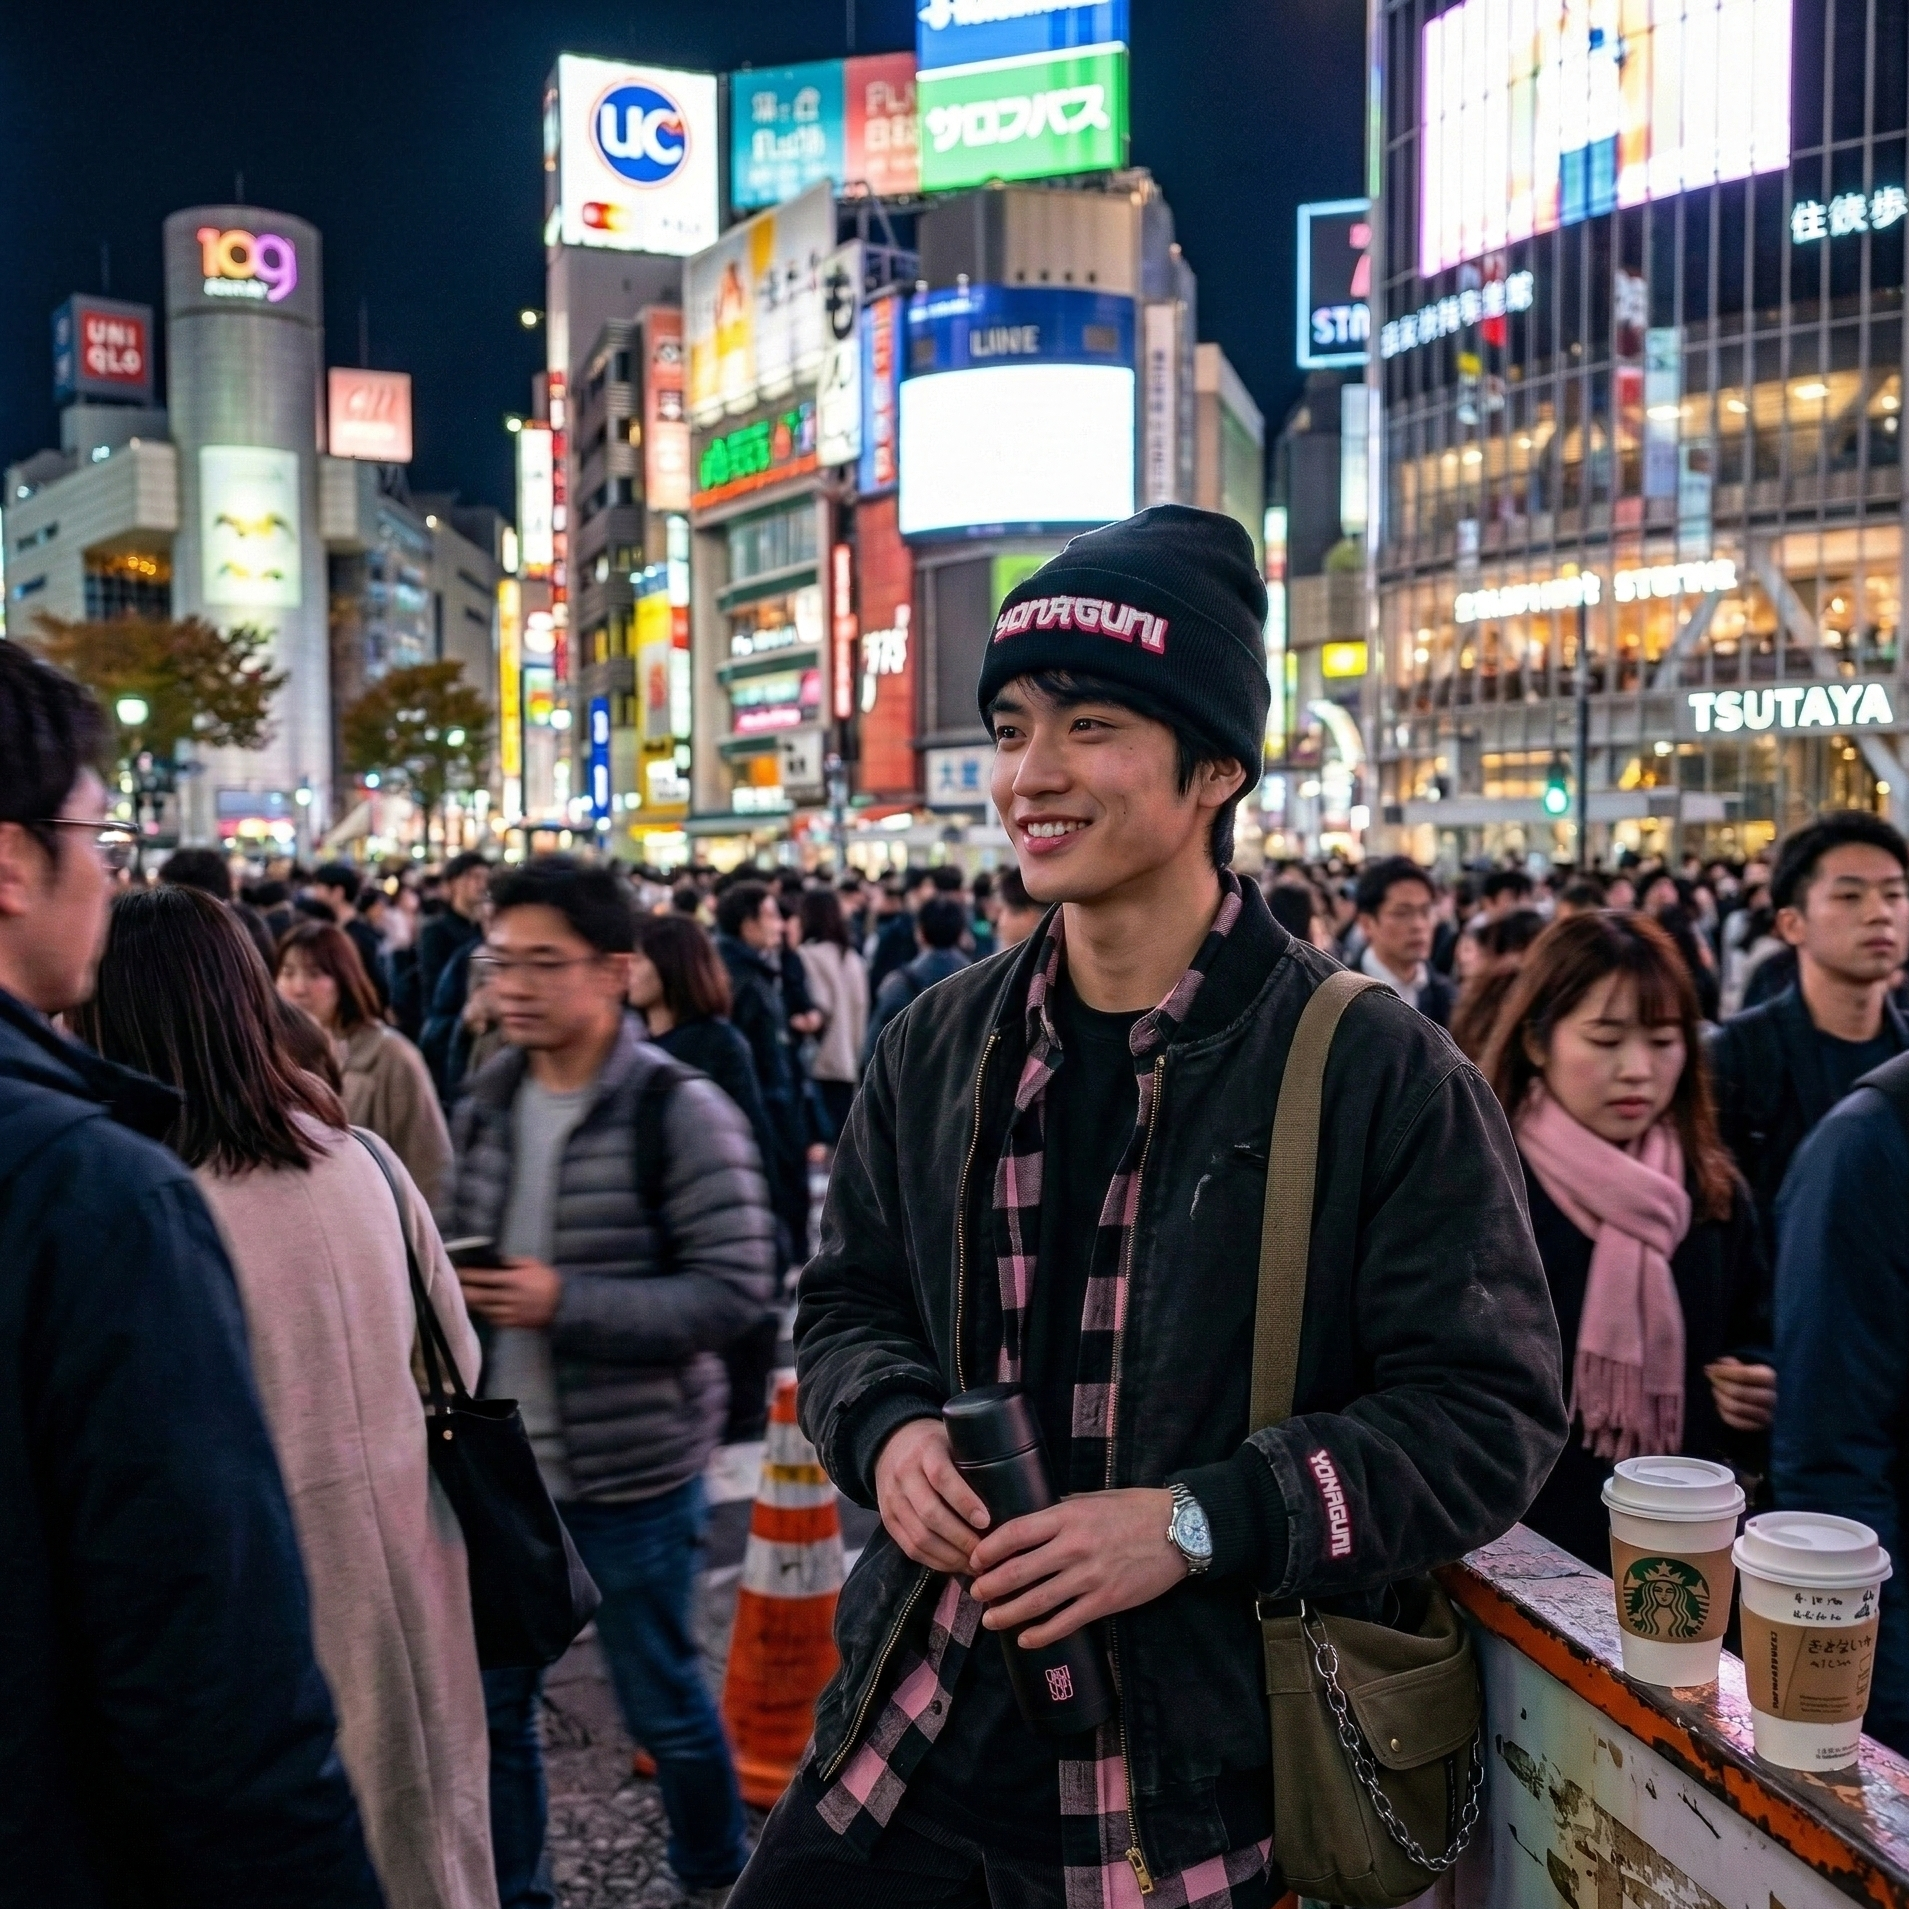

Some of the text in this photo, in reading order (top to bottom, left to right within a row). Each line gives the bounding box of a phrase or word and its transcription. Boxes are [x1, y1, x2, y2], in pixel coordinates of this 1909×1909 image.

[600, 103, 684, 166] UC
[197, 227, 298, 303] 109
[1688, 683, 1893, 732] TSUTAYA
[1310, 1449, 1351, 1557] YONAGUNI
